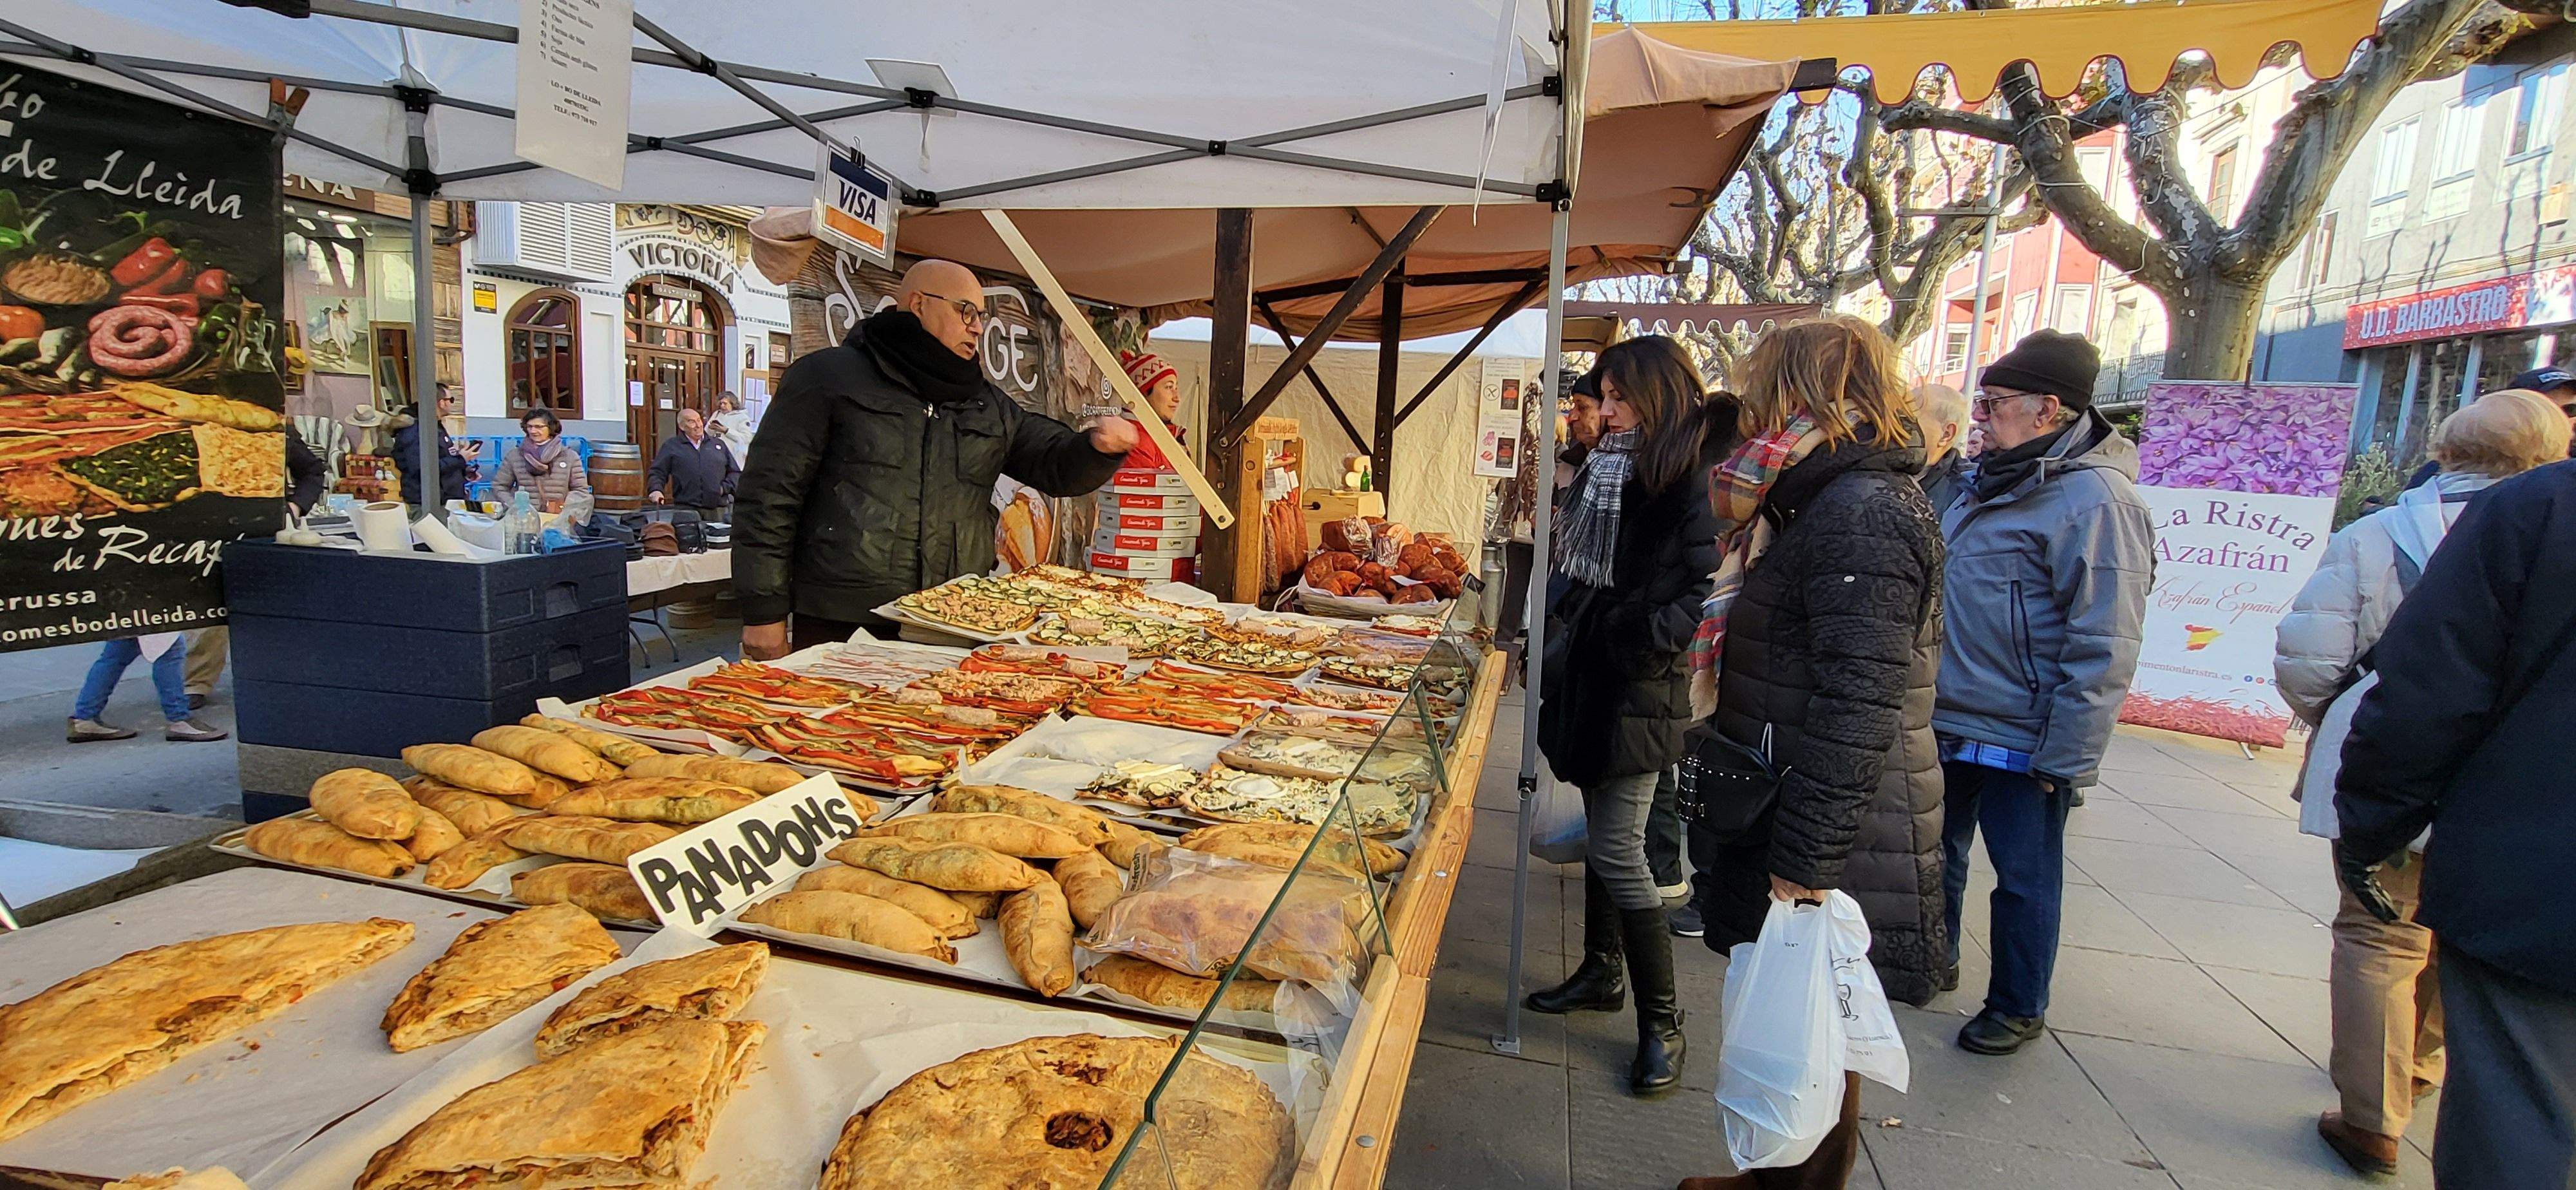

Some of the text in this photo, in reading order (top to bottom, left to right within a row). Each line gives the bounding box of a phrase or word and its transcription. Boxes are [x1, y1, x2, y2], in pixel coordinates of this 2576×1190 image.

[1, 139, 58, 180] de
[838, 178, 876, 225] VISA
[628, 242, 735, 294] VICTORIA
[2394, 285, 2508, 335] BARBASTRO
[2202, 500, 2316, 551] Ristra
[53, 546, 86, 573] de
[2153, 536, 2289, 574] Azafrán
[638, 796, 859, 926] PANADONS
